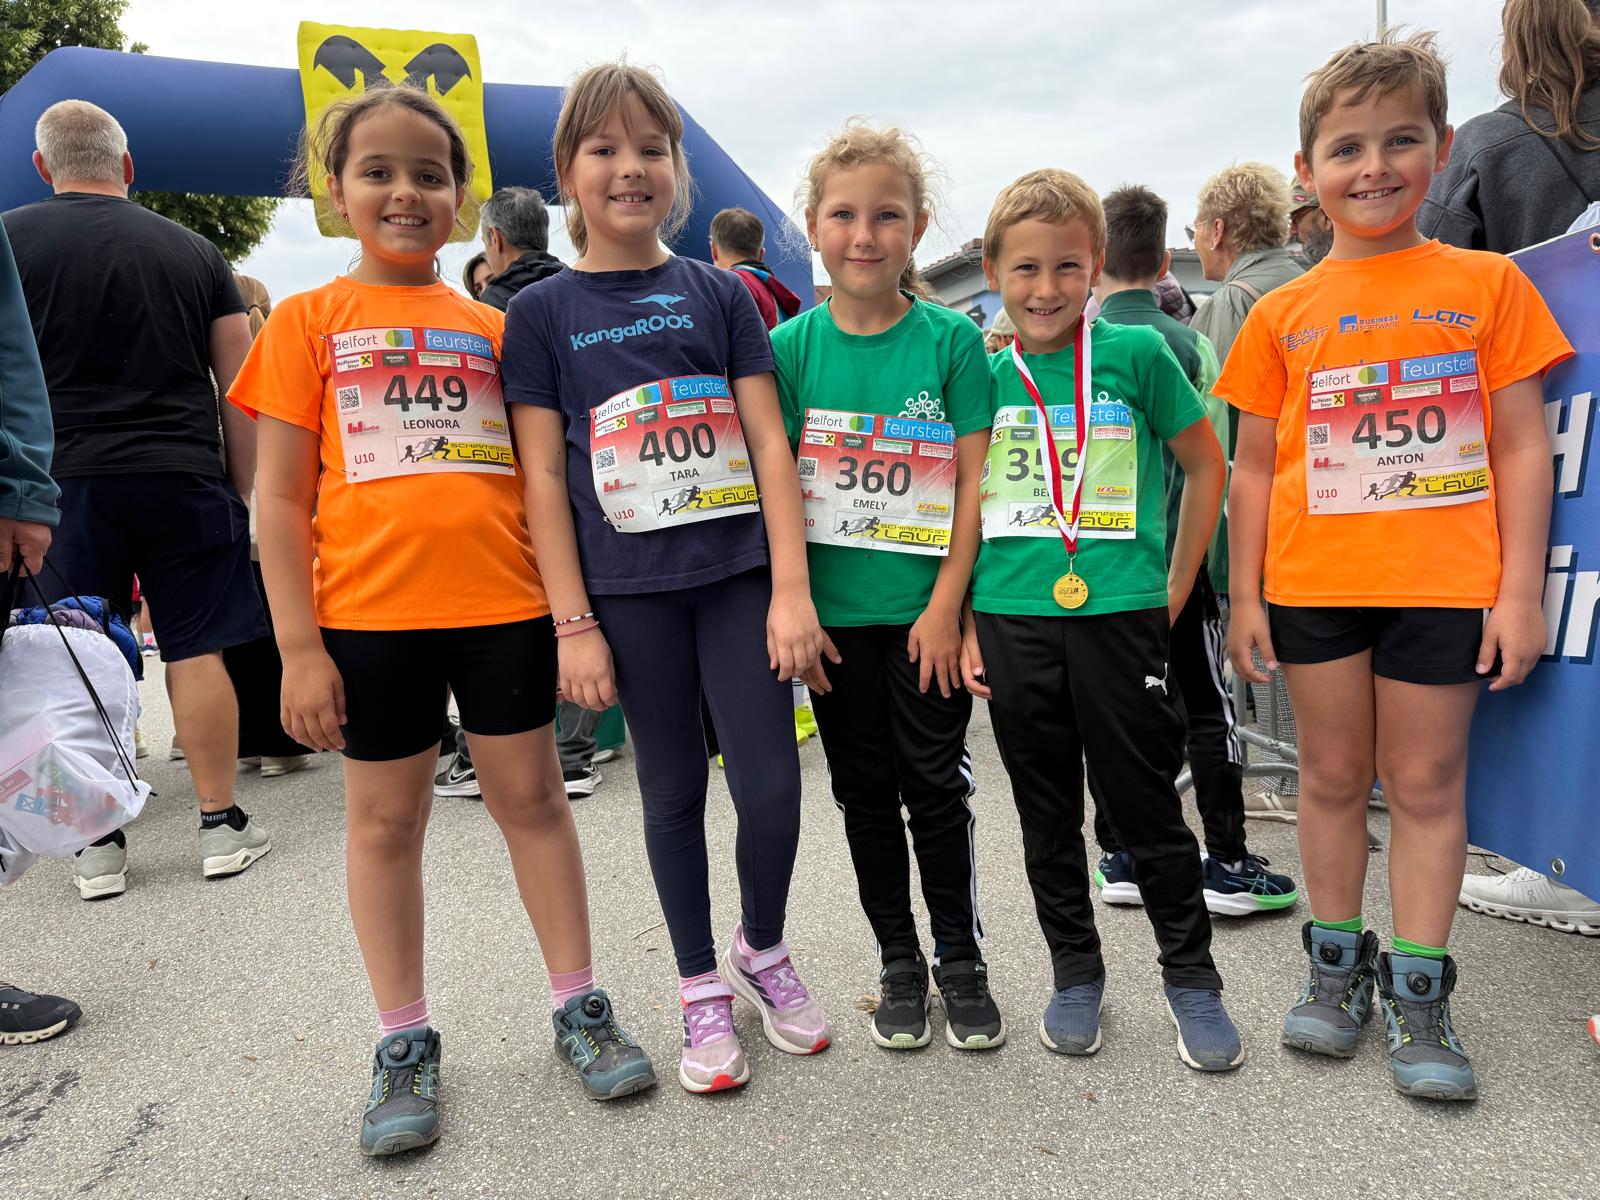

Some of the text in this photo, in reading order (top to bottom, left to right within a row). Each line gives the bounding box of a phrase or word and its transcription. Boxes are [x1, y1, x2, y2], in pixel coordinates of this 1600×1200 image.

[570, 314, 694, 351] KangaROOS
[335, 334, 378, 351] delfort
[425, 331, 492, 354] feurstein
[1402, 355, 1476, 377] feurstein
[672, 379, 728, 397] feurstein
[1312, 373, 1351, 389] delfort
[383, 374, 468, 412] 449
[596, 397, 631, 421] delfort
[1053, 407, 1130, 423] festein
[403, 419, 461, 430] LEONORA
[807, 416, 843, 427] delfort
[1352, 405, 1447, 450] 450
[884, 419, 955, 441] feurstein
[639, 422, 716, 467] 400
[354, 452, 375, 464] U10
[457, 449, 511, 461] LAUF
[1376, 452, 1424, 467] ANTON
[670, 468, 700, 481] TARA
[835, 456, 911, 497] 360
[1425, 474, 1487, 492] LAUF
[709, 490, 755, 505] LAUF
[1033, 488, 1050, 497] BE
[1316, 488, 1338, 499] U10
[853, 499, 887, 510] EMELY
[614, 509, 635, 520] U10
[804, 518, 815, 528] 10
[885, 530, 947, 543] LAUF
